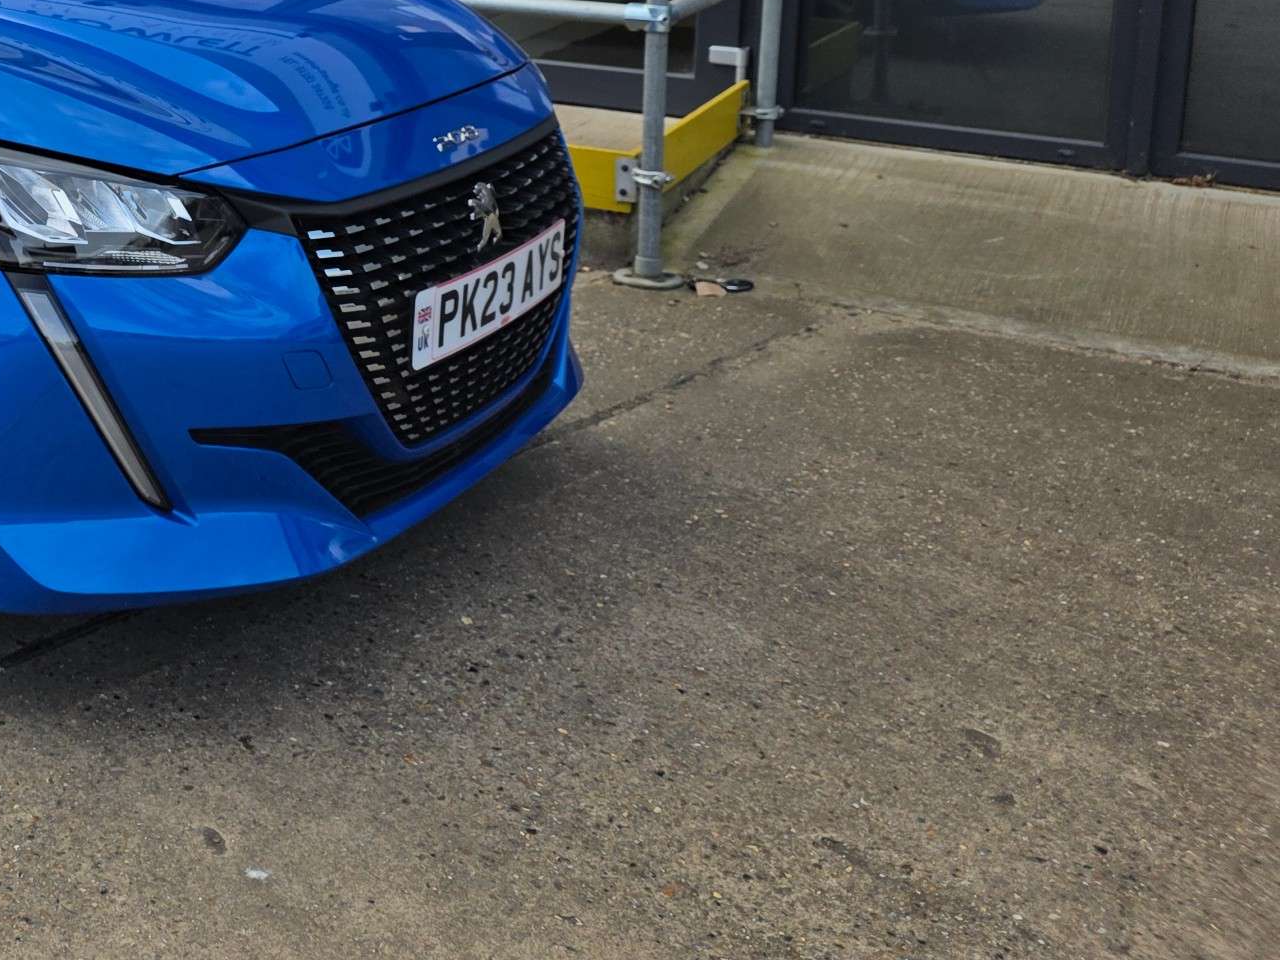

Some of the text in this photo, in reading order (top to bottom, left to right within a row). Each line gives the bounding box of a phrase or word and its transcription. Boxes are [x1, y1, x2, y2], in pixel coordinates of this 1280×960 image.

[438, 231, 561, 348] PK23 AYS
[417, 333, 430, 352] UK
